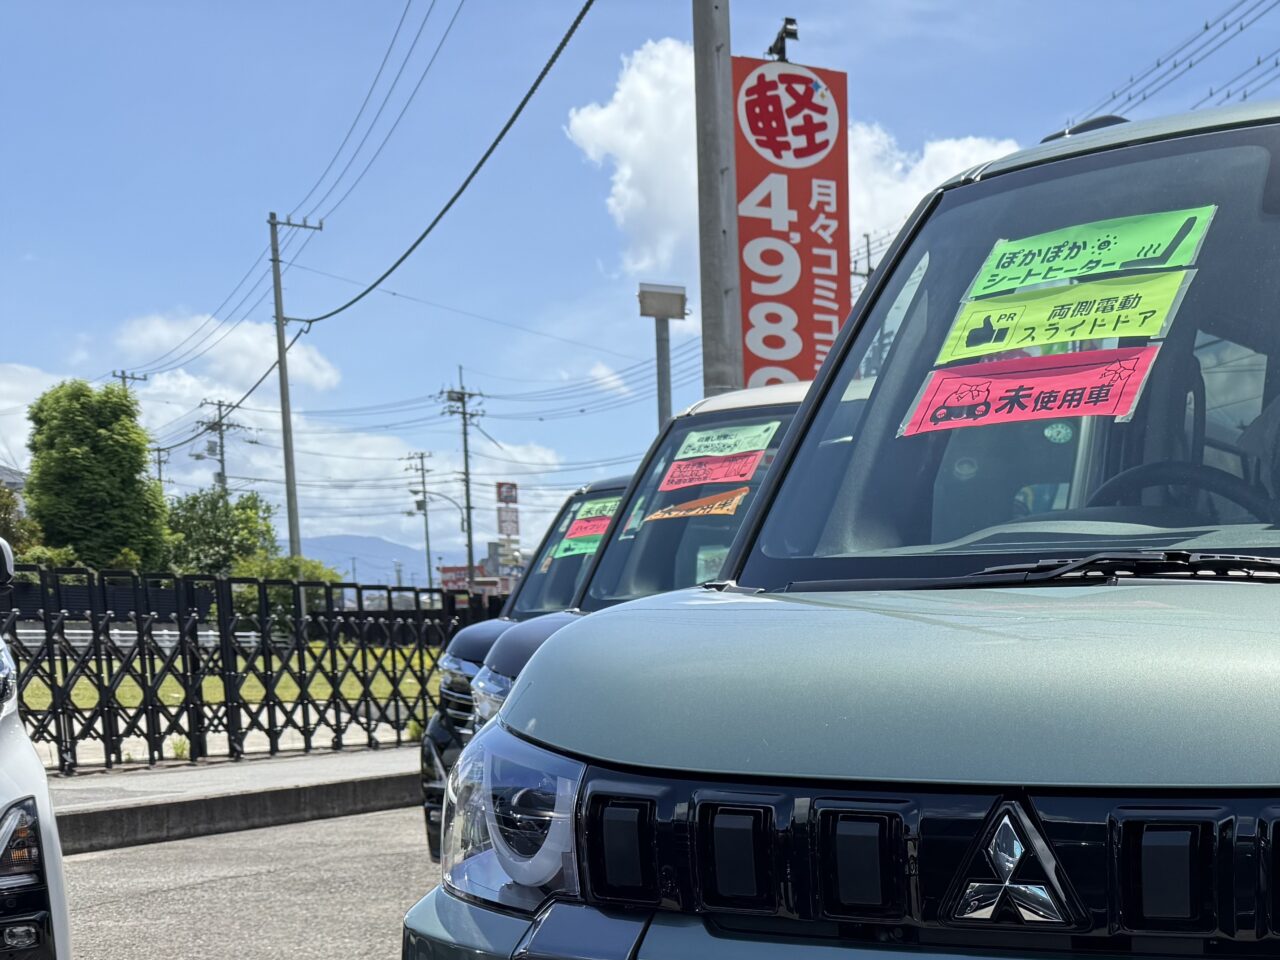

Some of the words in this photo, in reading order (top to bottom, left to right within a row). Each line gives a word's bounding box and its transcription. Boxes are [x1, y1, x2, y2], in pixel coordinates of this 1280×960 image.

[744, 73, 829, 160] 軽
[995, 241, 1087, 270] ぽかぽか
[982, 260, 1116, 290] シートヒーター
[996, 312, 1017, 323] PR
[1047, 293, 1142, 322] 両側電動
[1017, 310, 1157, 344] スライドドア
[994, 383, 1114, 415] 未使用車
